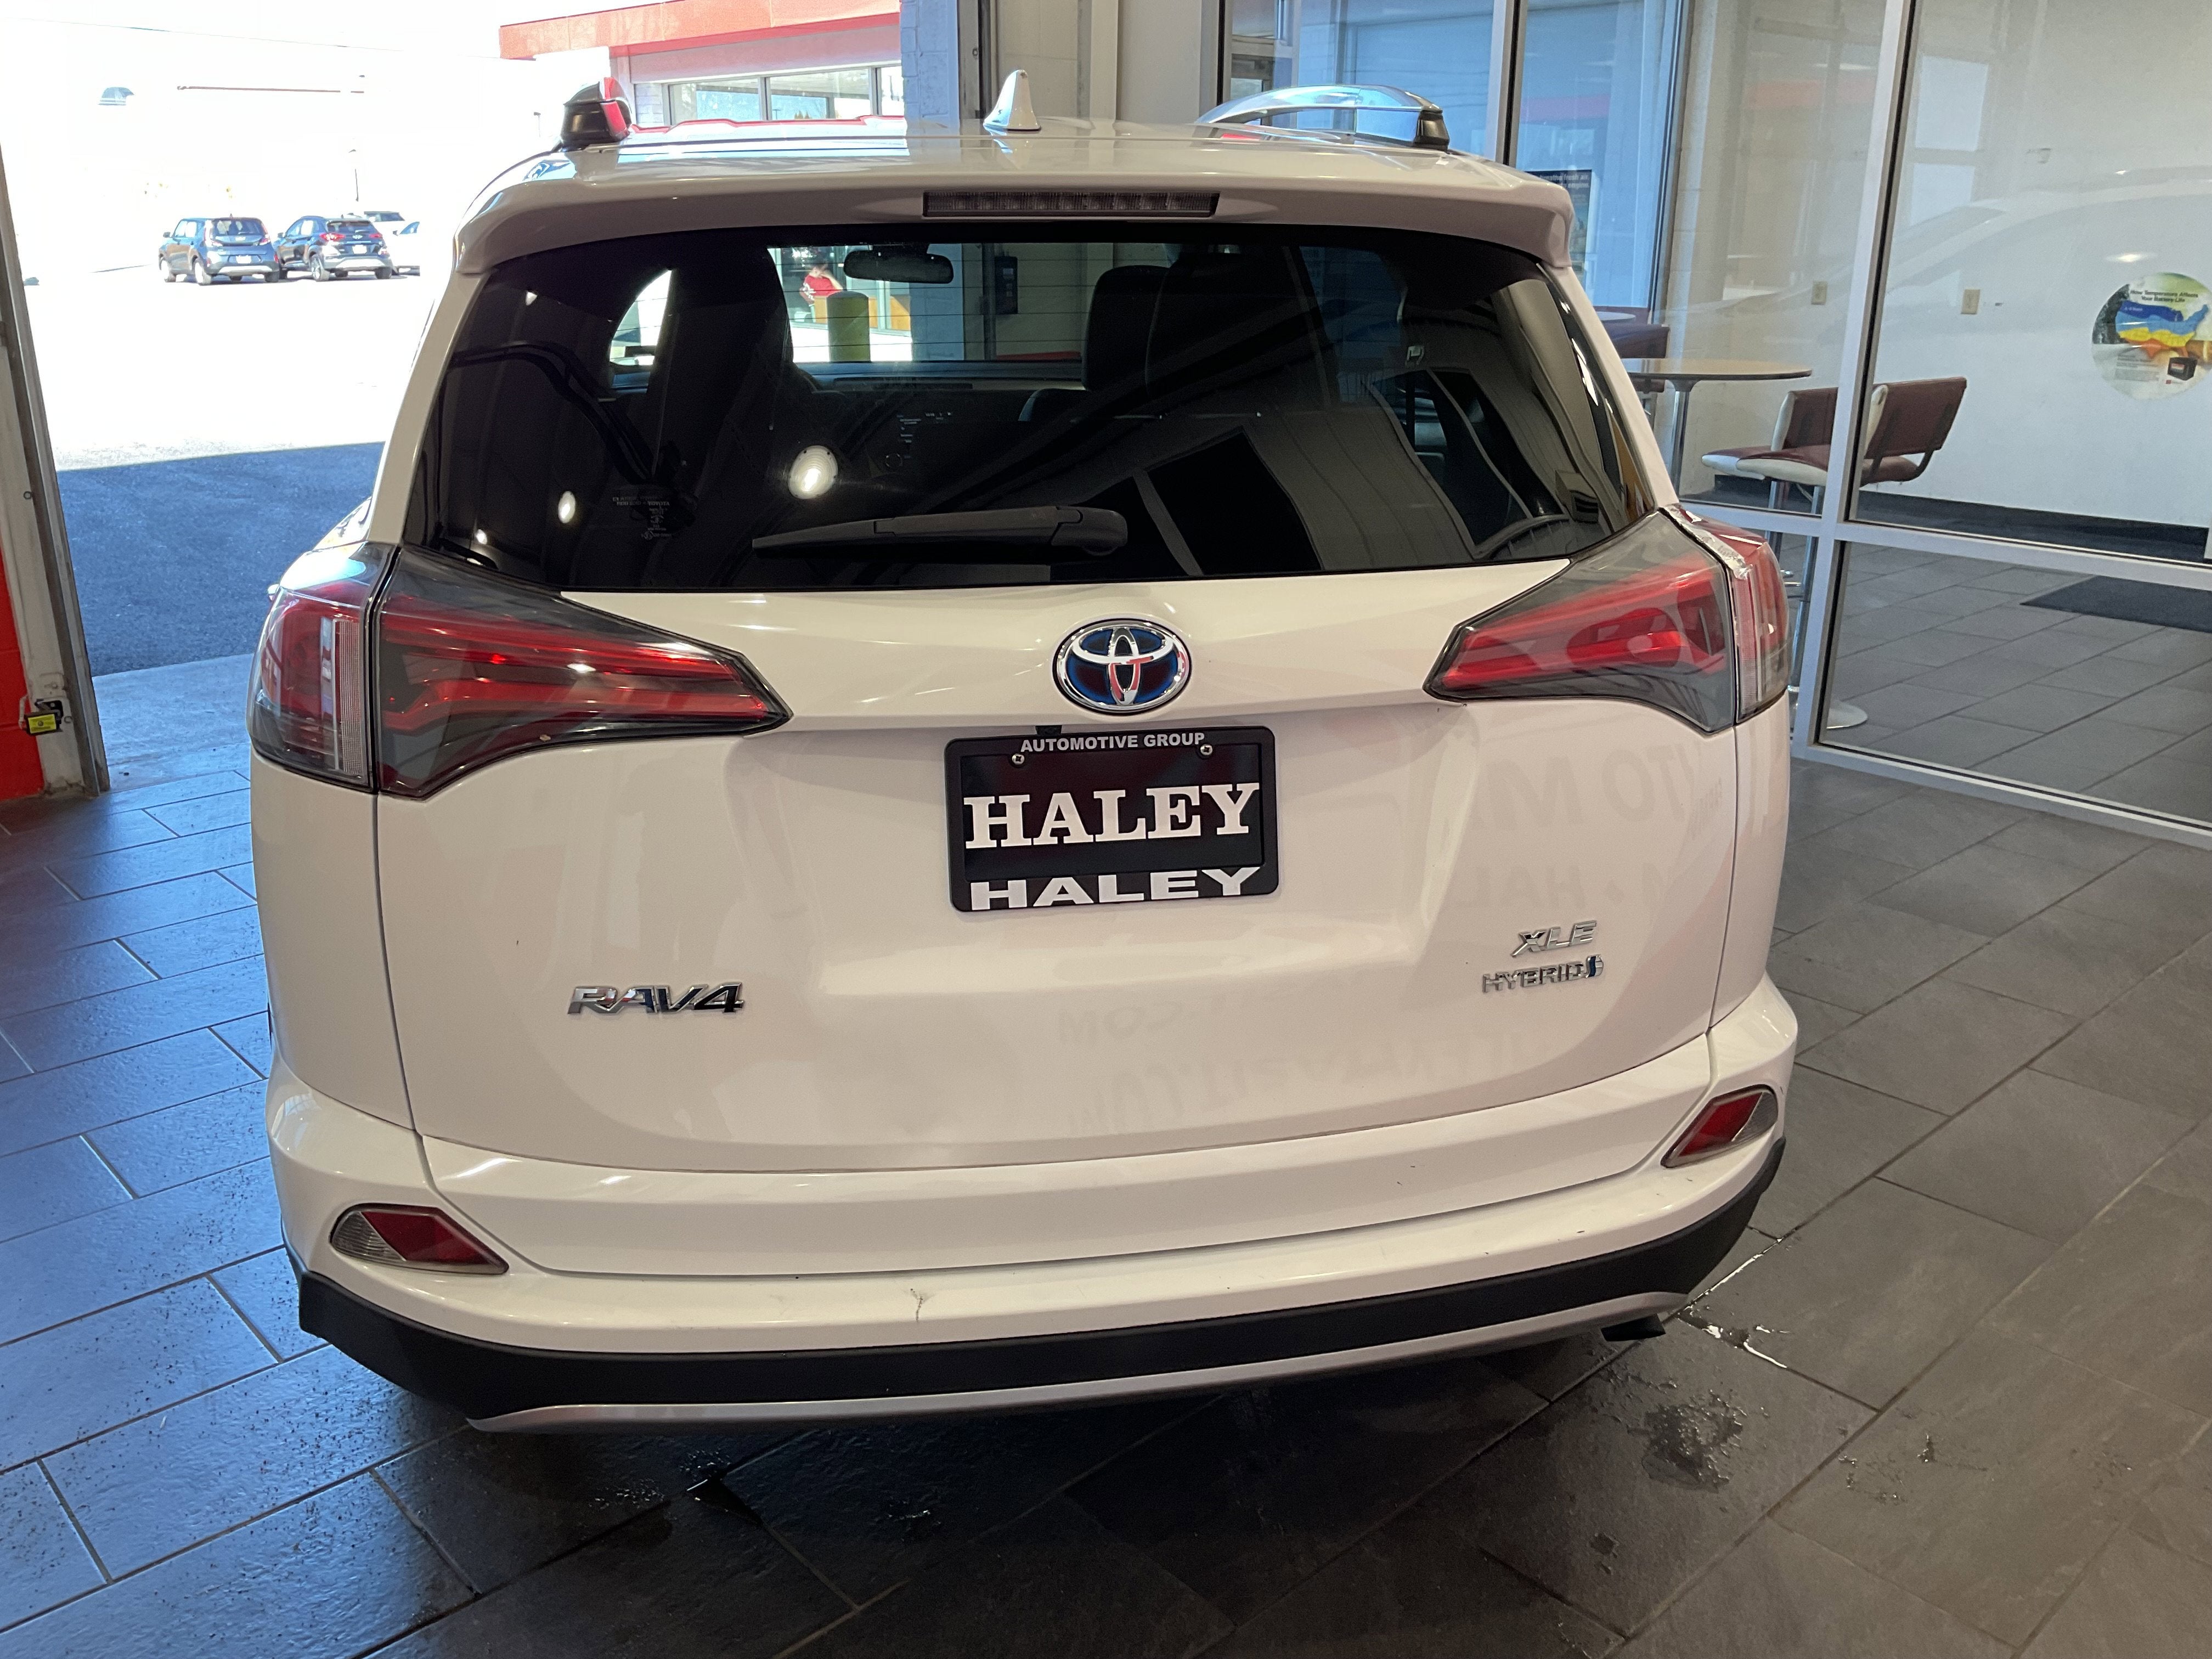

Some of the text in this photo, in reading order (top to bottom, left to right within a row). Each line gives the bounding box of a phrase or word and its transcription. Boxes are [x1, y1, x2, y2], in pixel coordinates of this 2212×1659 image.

[1020, 732, 1205, 752] AUTOMOTIVE GROUP
[963, 782, 1260, 849] HALEY
[970, 867, 1261, 911] HALEY
[1511, 919, 1597, 957] XLE
[1482, 961, 1585, 992] HYBRID
[567, 981, 744, 1014] RAV4
